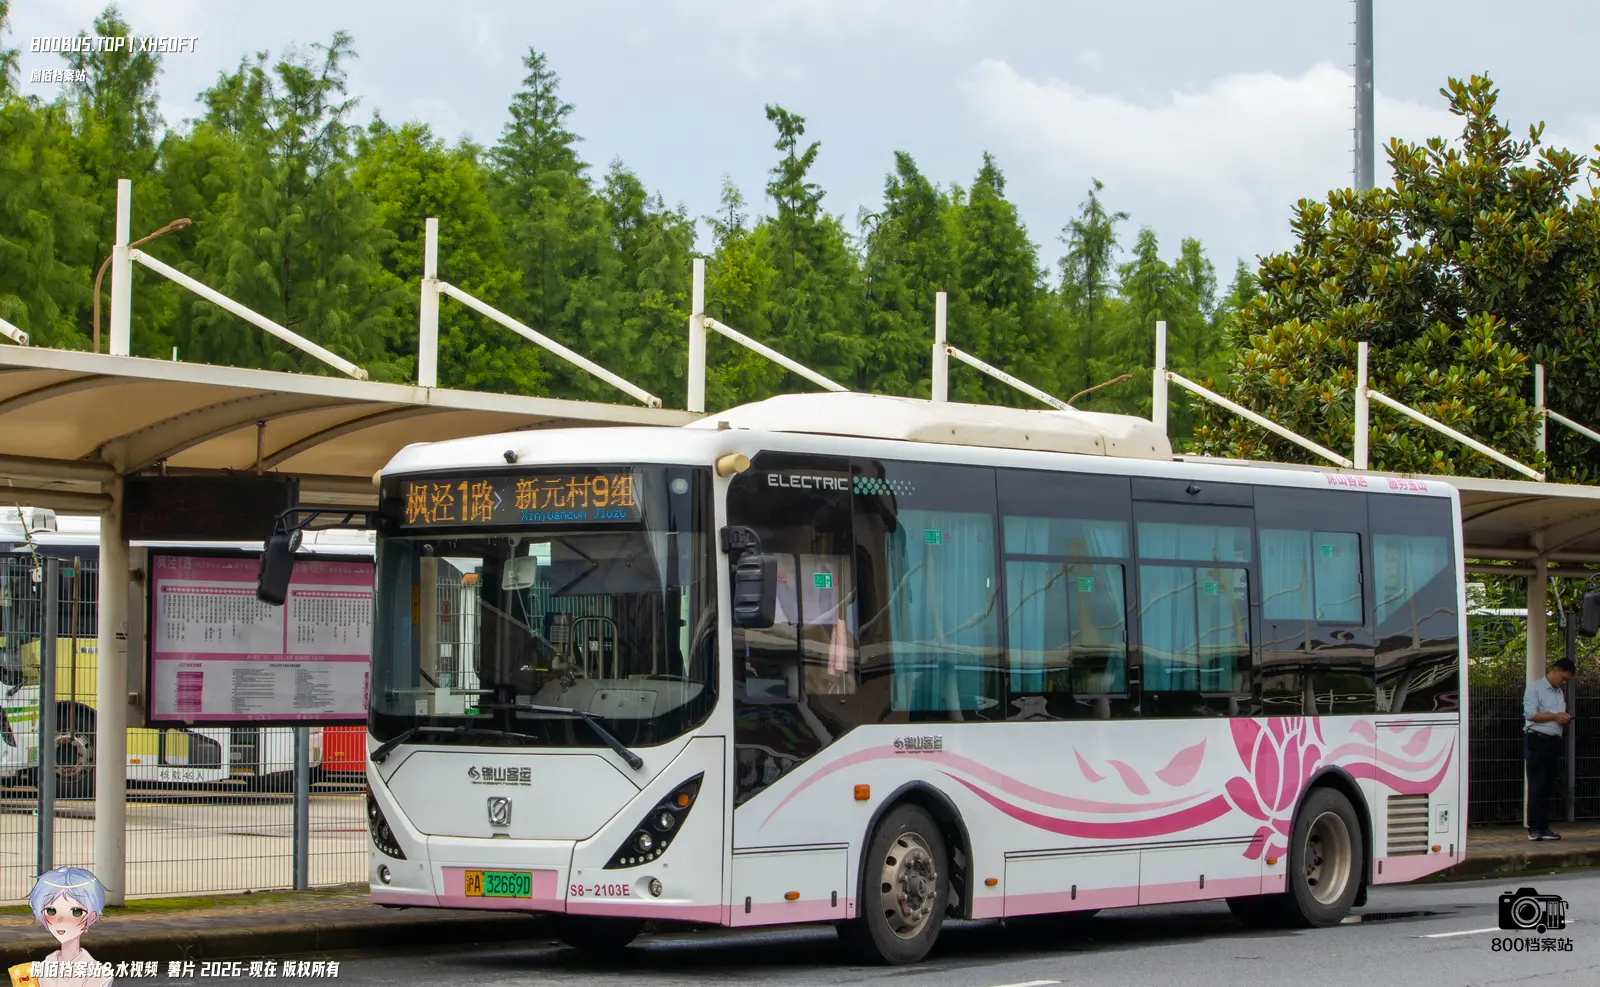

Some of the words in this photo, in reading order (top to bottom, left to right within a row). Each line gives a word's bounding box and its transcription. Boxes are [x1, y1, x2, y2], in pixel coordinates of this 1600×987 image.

[767, 473, 849, 491] ELECTRIC
[406, 480, 496, 525] 枫泾1路
[515, 474, 636, 510] 新元村9组
[593, 508, 628, 520] Jiuzu
[570, 884, 631, 897] S8-2103E
